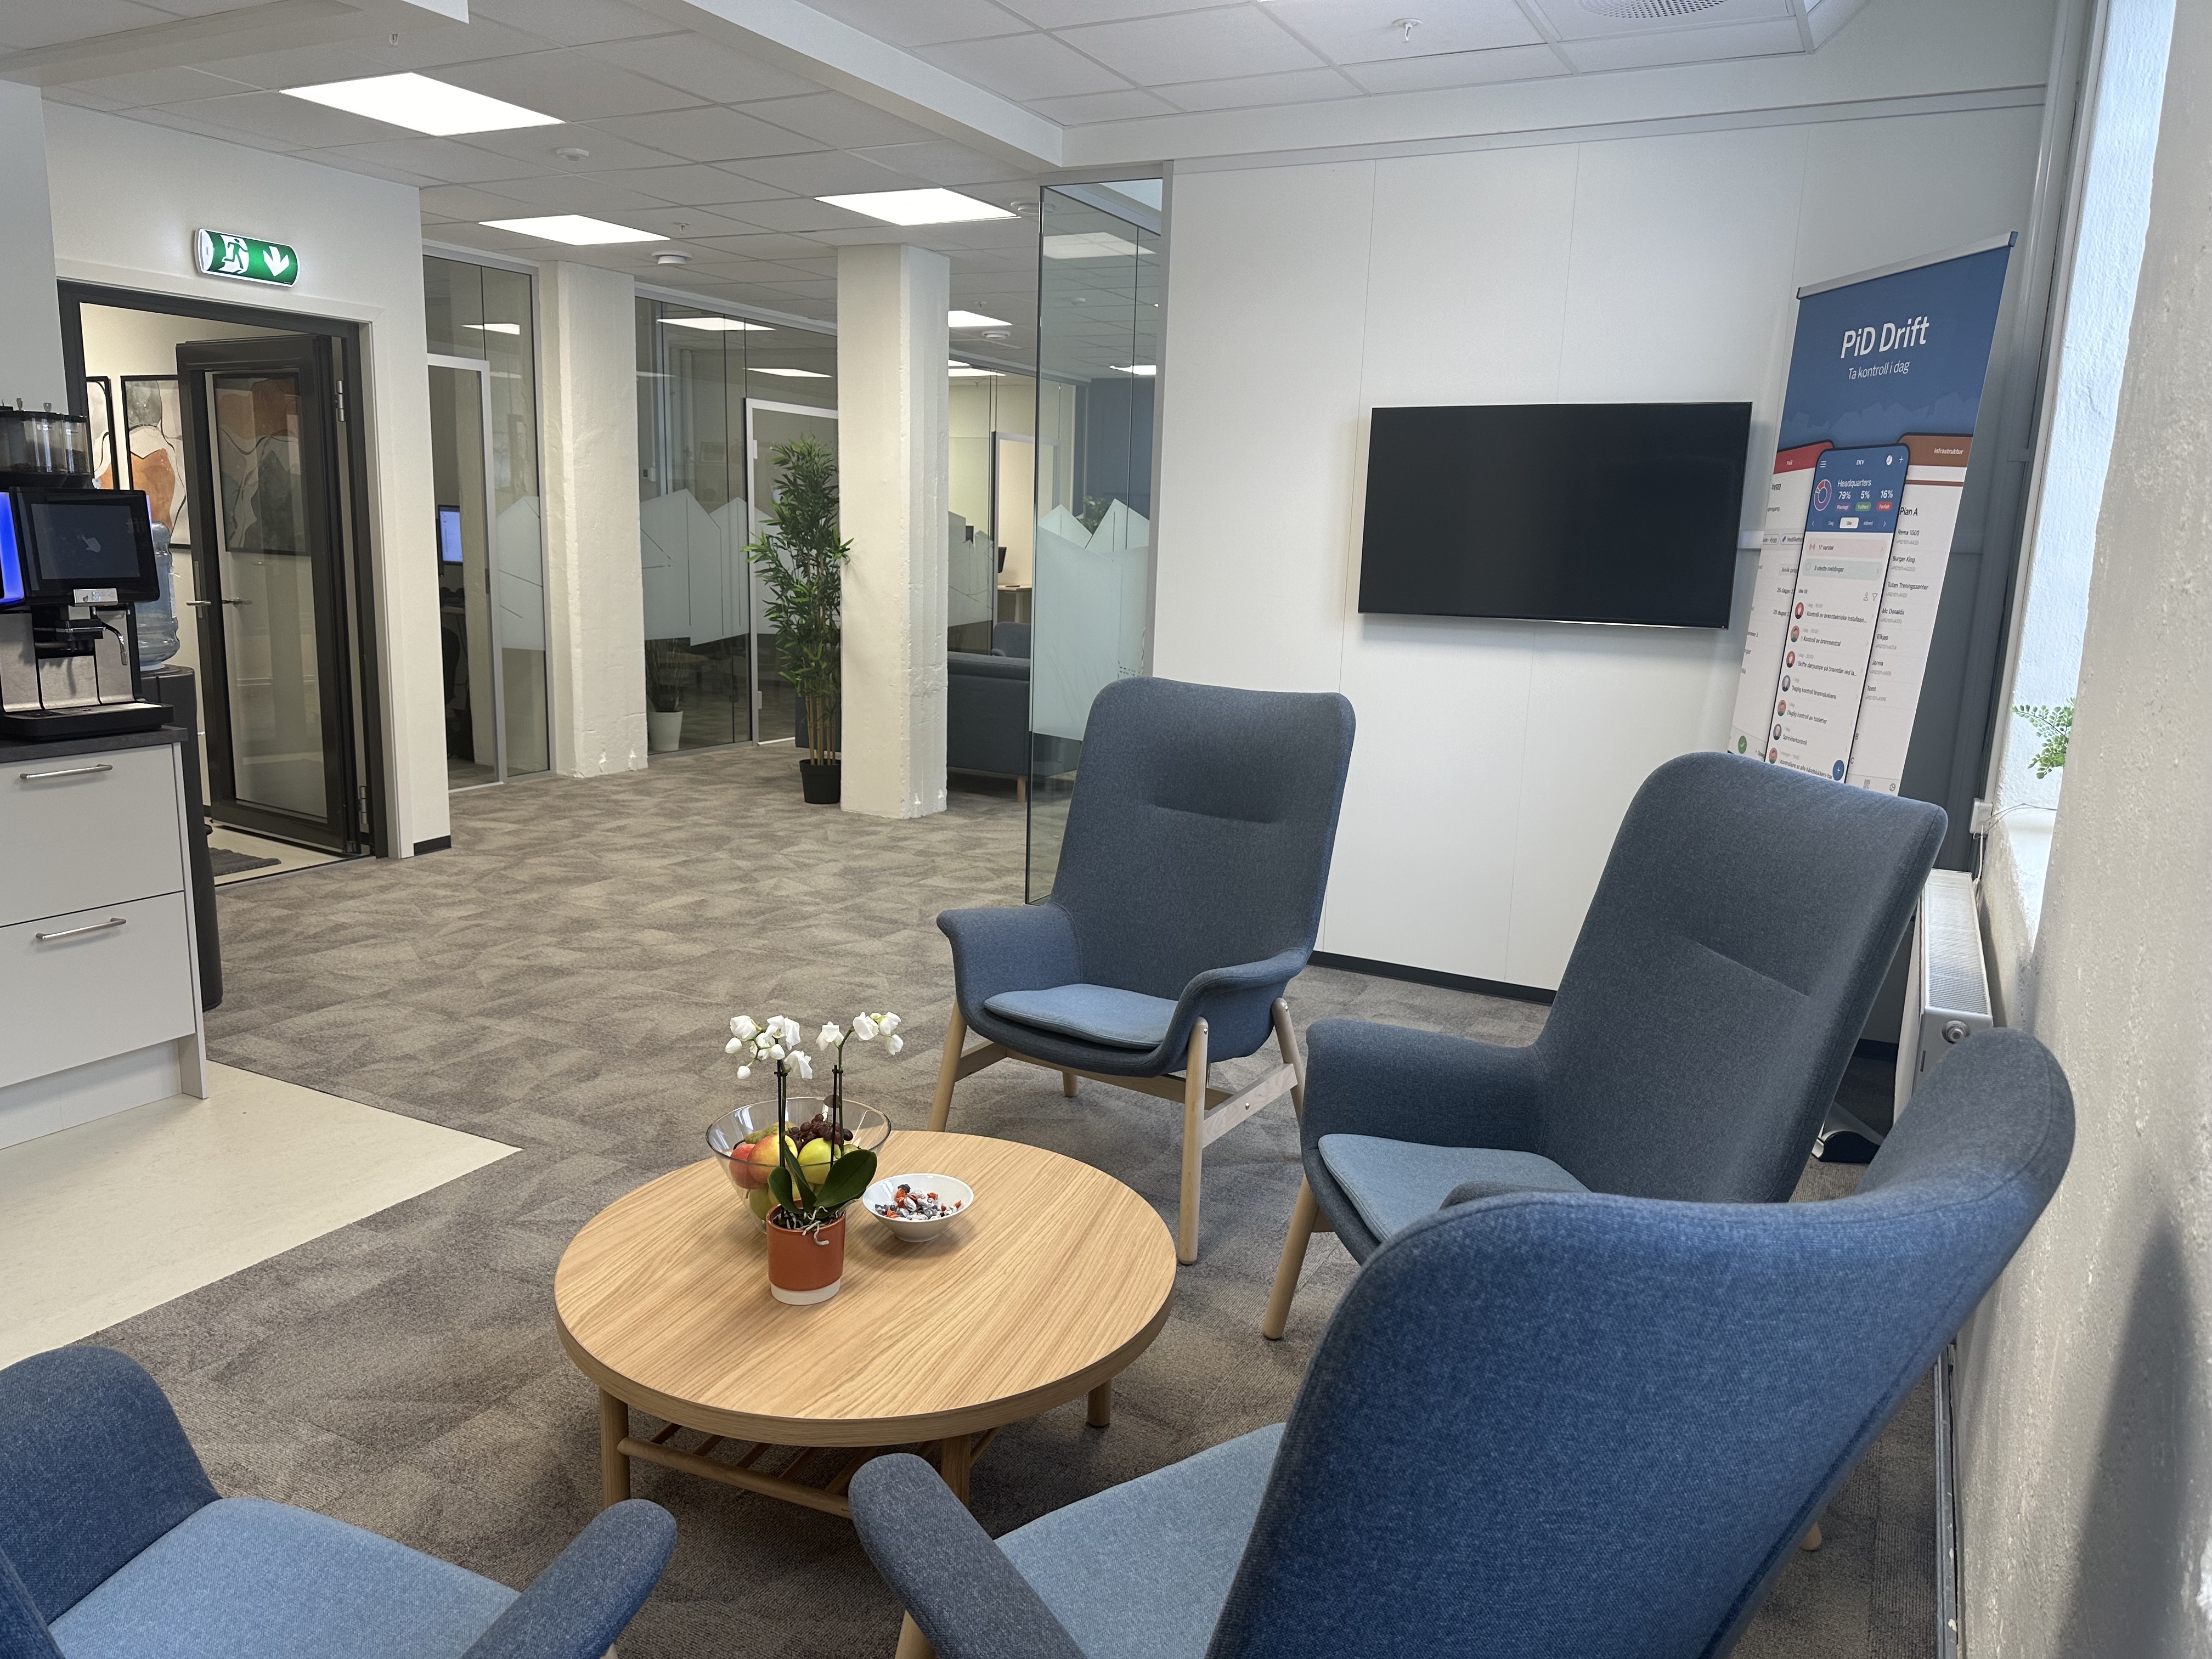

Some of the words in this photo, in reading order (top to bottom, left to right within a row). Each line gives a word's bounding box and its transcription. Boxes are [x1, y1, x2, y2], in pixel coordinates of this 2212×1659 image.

[1841, 326, 1875, 359] PiD
[1878, 316, 1929, 352] Drift
[1848, 368, 1856, 380] Ta
[1858, 362, 1889, 379] kontroll
[1893, 360, 1910, 374] dag
[1837, 479, 1872, 488] Headquarters
[1838, 491, 1851, 500] 79%
[1860, 490, 1870, 499] 5%
[1881, 489, 1893, 499] 16%
[1899, 507, 1912, 516] Plan
[1913, 507, 1918, 516] A
[1899, 582, 1929, 590] Treningssenter
